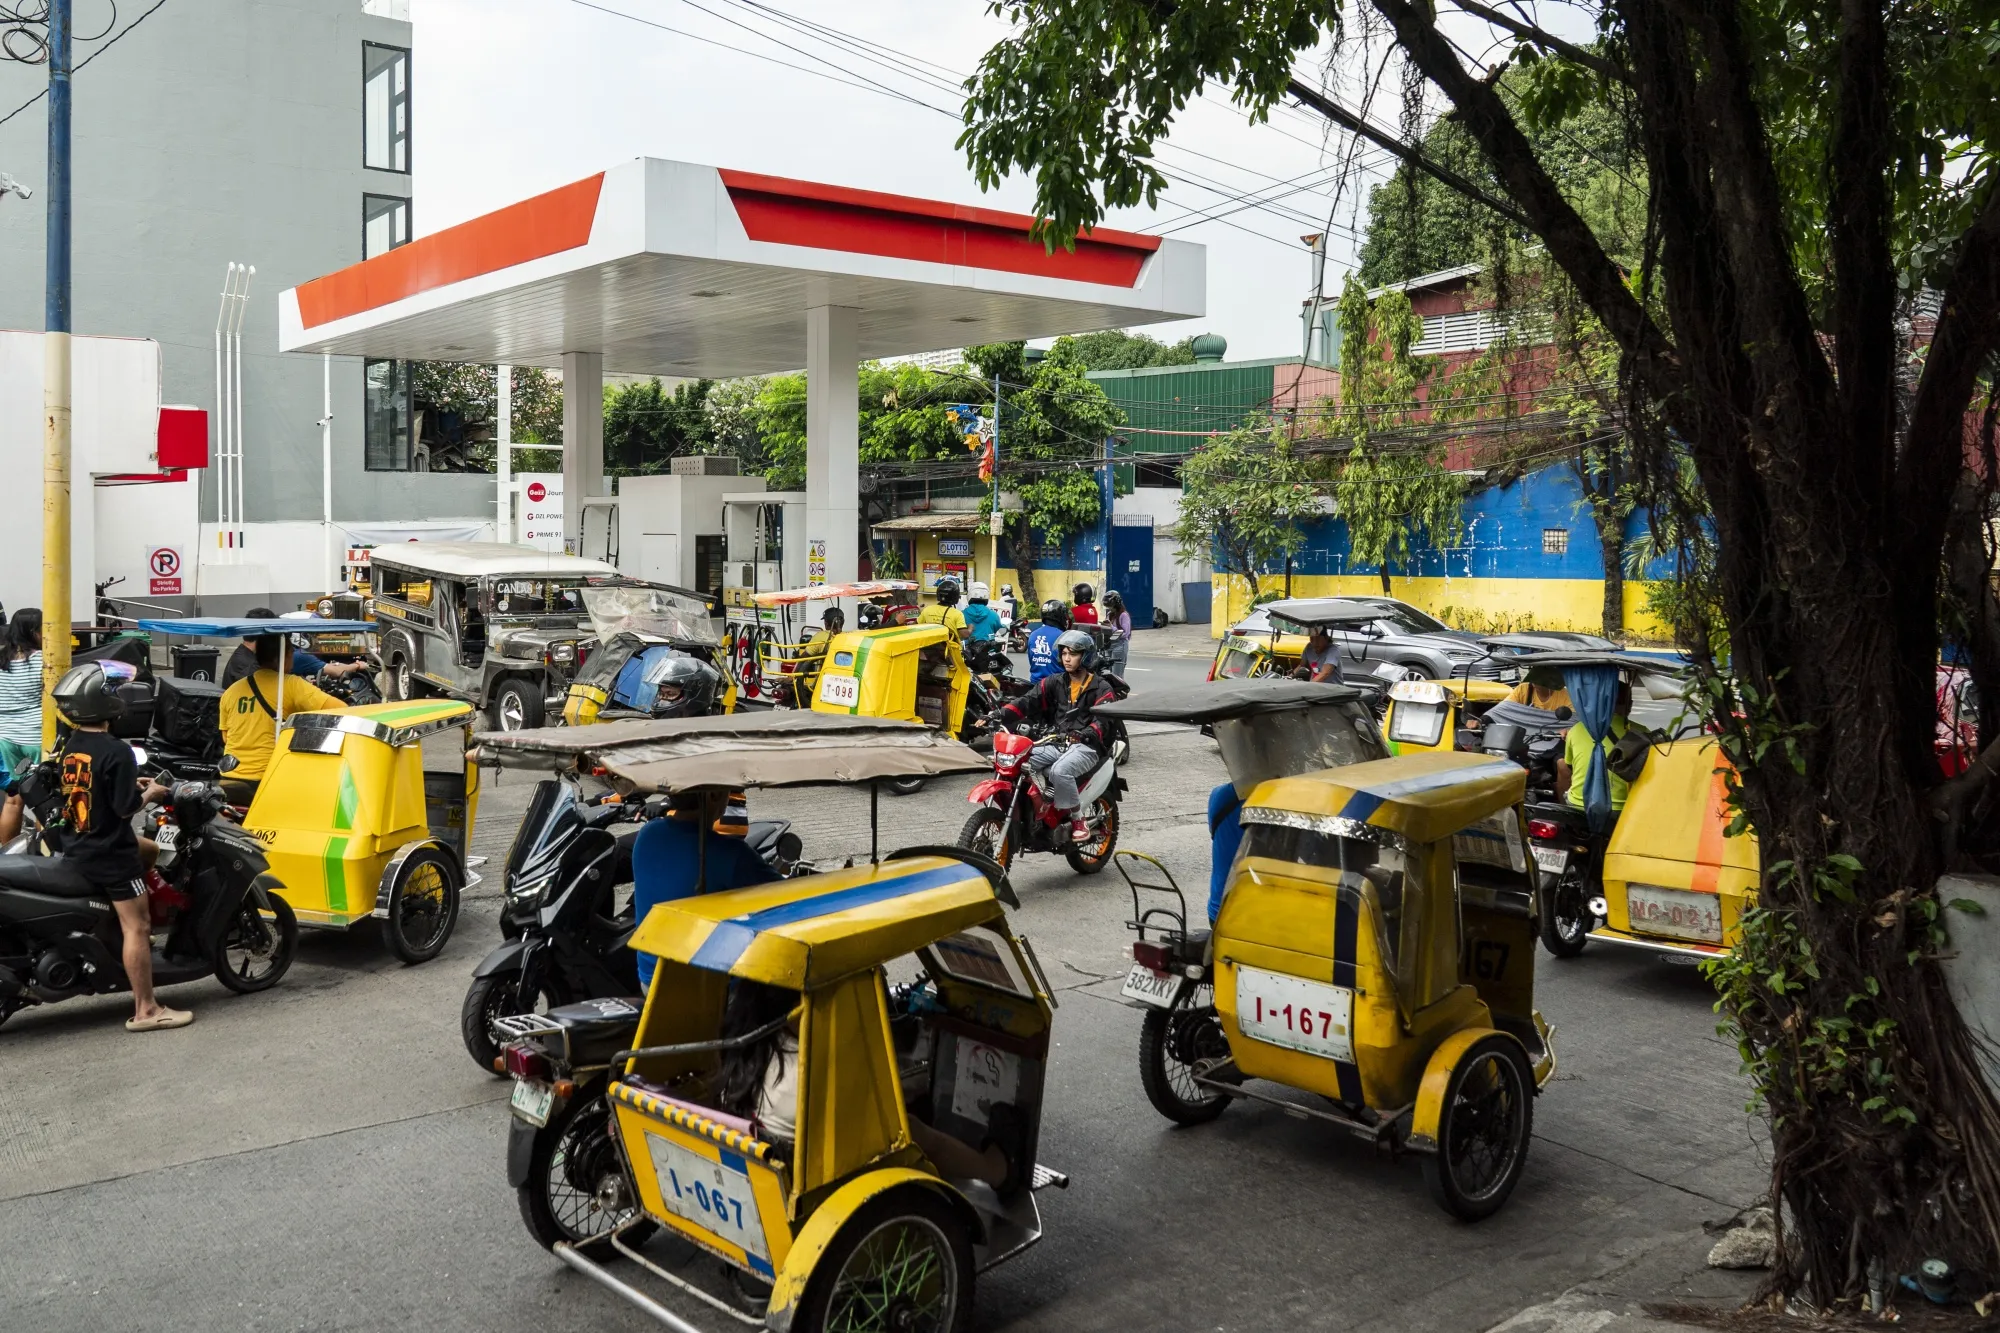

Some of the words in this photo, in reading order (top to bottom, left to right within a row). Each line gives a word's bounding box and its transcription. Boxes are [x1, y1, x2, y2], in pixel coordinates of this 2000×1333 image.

[946, 543, 968, 551] LOTTO
[88, 900, 110, 911] YAMAHA
[1632, 900, 1713, 927] MC-021
[1126, 972, 1177, 999] 382XKY
